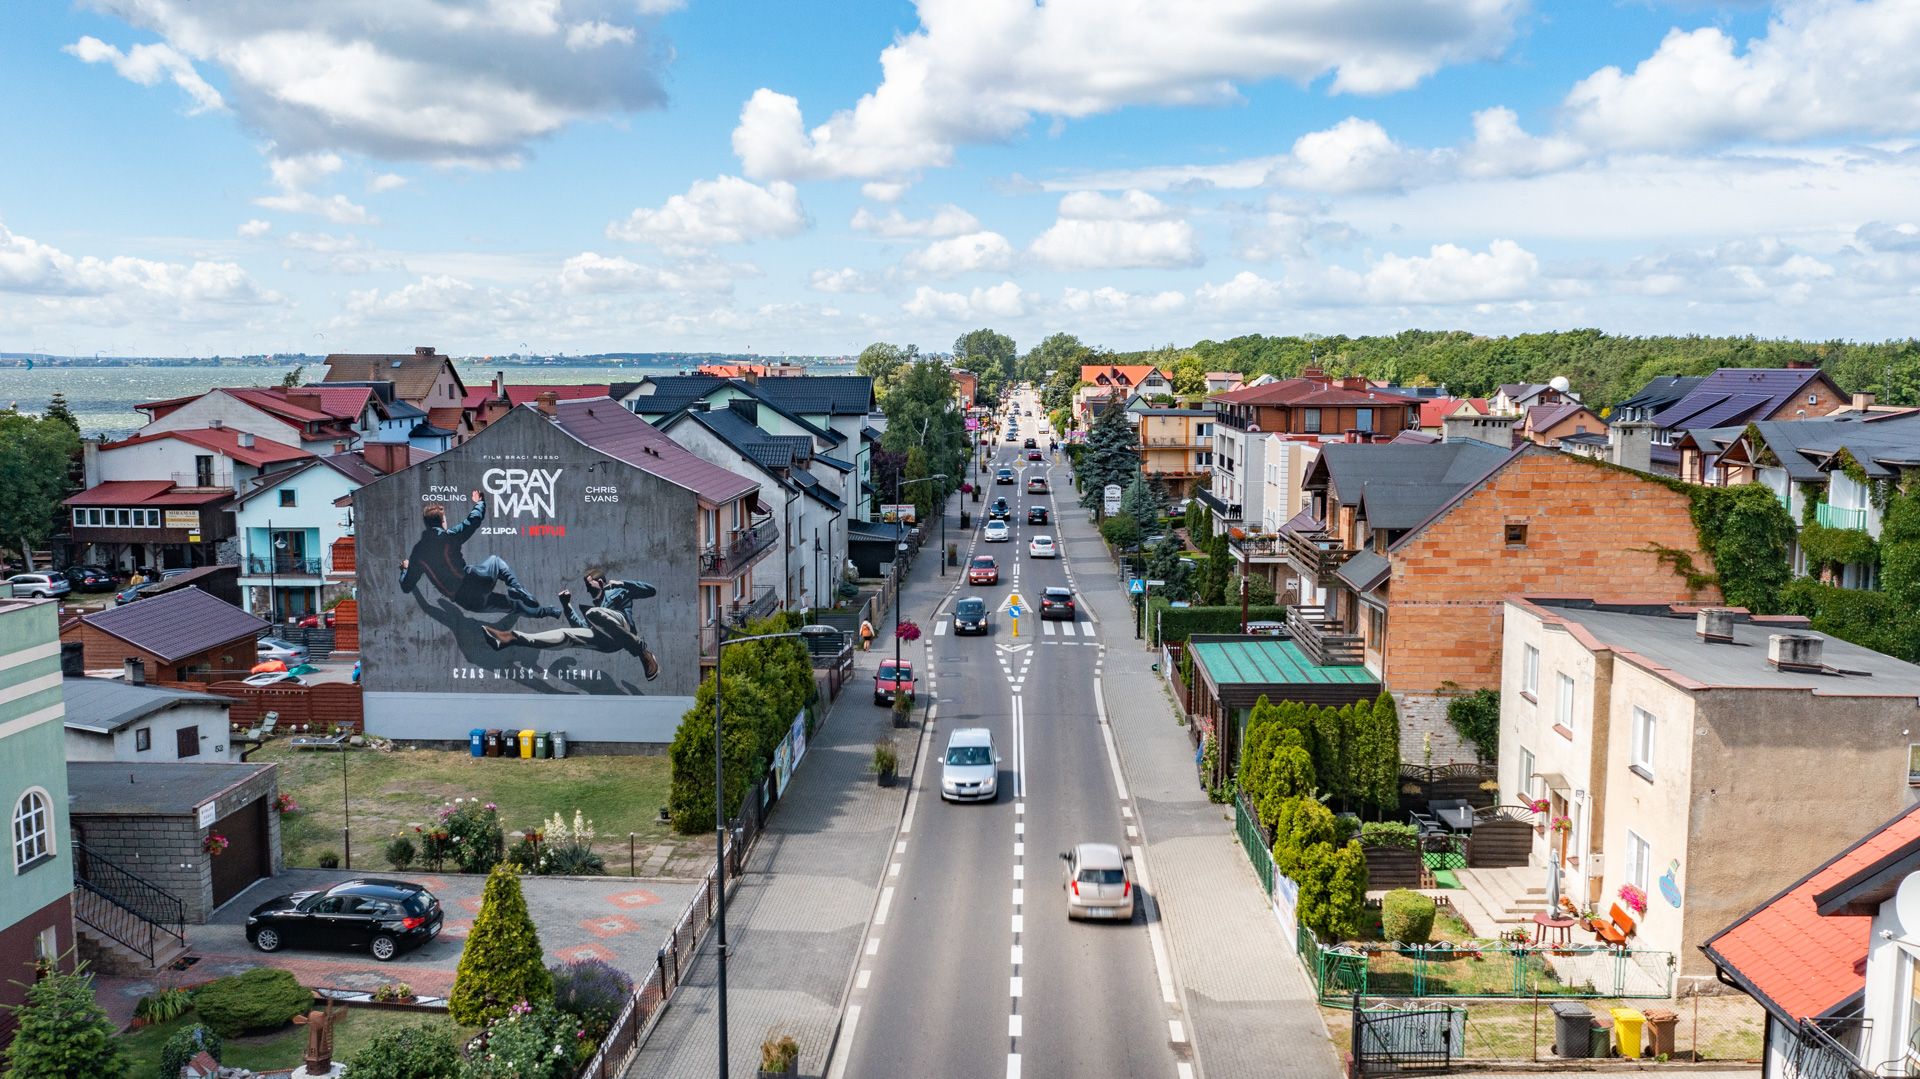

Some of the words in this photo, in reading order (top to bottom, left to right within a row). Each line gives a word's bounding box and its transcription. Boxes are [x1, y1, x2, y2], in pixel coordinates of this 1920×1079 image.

[482, 468, 564, 495] GRAY
[585, 486, 617, 494] CHRIS
[421, 494, 467, 502] GOSLING
[584, 495, 619, 503] EVANS
[493, 492, 556, 519] MAN
[481, 527, 492, 535] 22
[493, 527, 518, 535] LIPCA
[453, 668, 484, 679] CZAS
[494, 667, 534, 680] WYJŚĆ
[543, 669, 548, 680] Z
[558, 669, 602, 680] CIENIA
